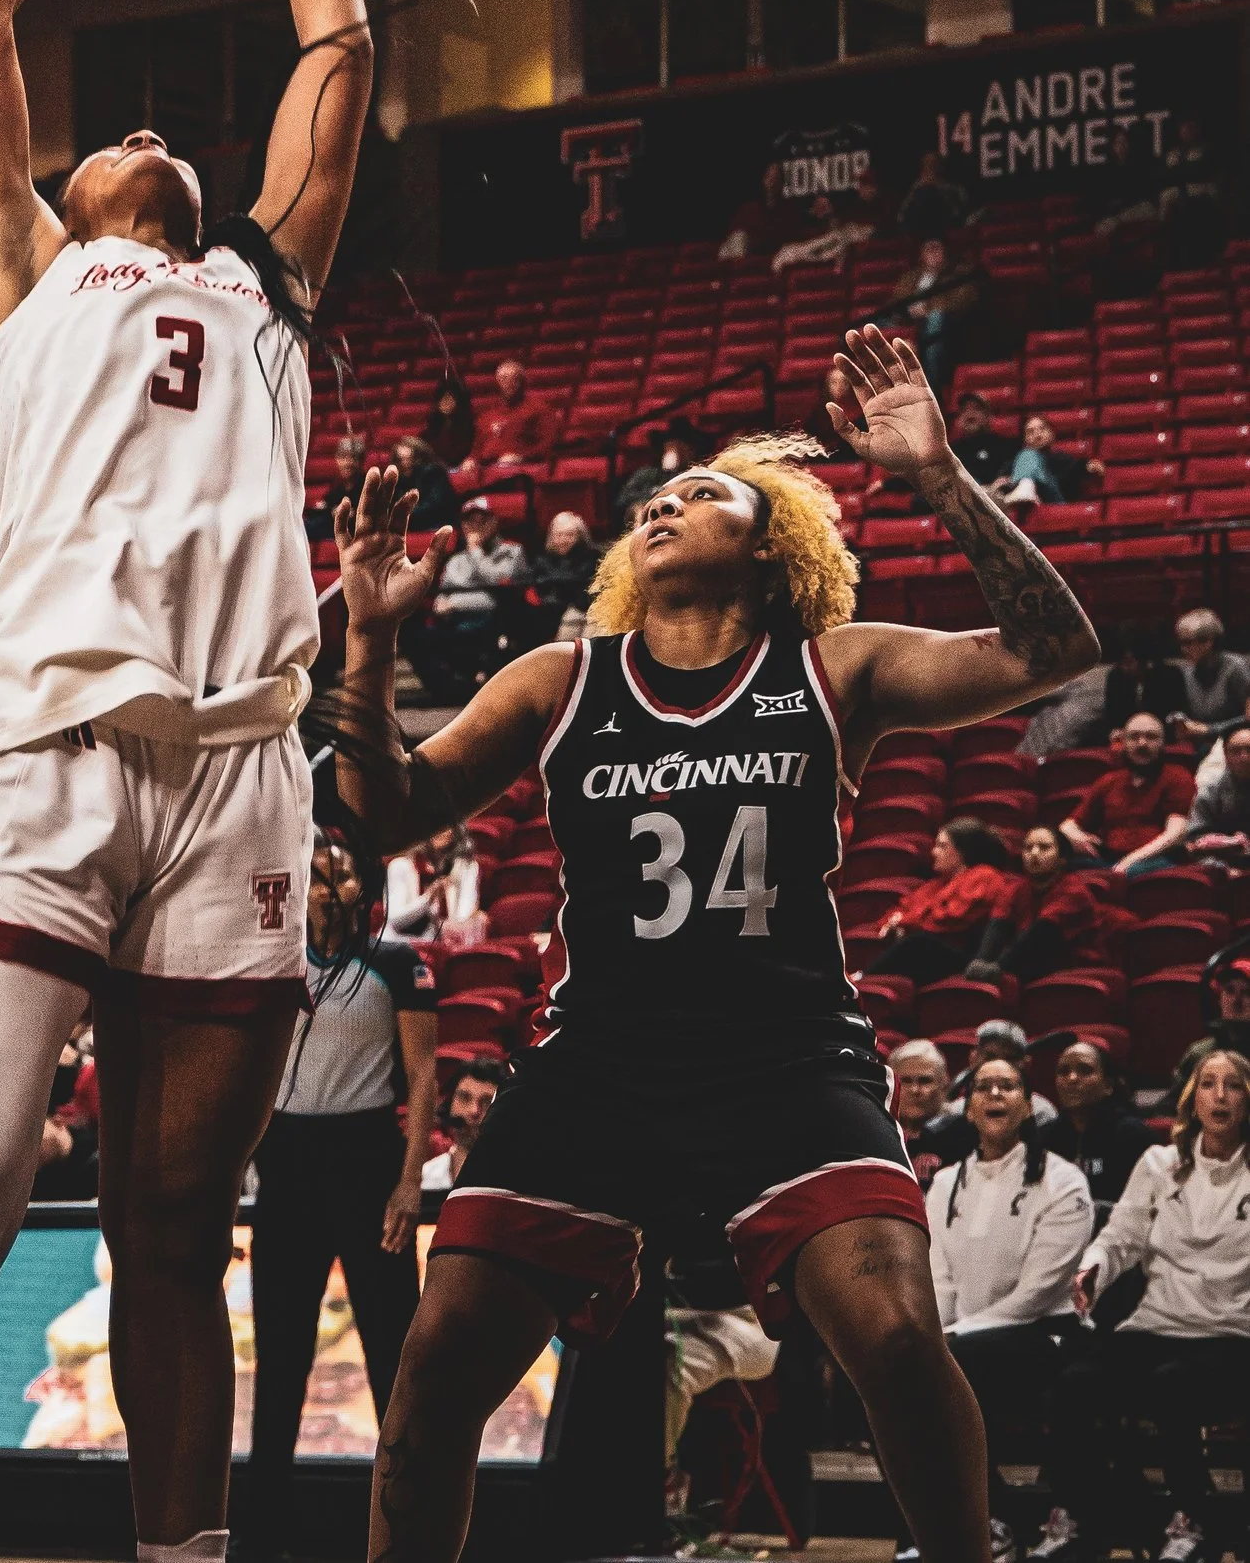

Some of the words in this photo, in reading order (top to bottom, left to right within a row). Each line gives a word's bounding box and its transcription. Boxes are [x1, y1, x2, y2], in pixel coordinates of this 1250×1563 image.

[981, 62, 1137, 127] ANDRE
[150, 316, 205, 413] 3
[582, 751, 811, 800] CINCINNATI
[630, 805, 779, 939] 34
